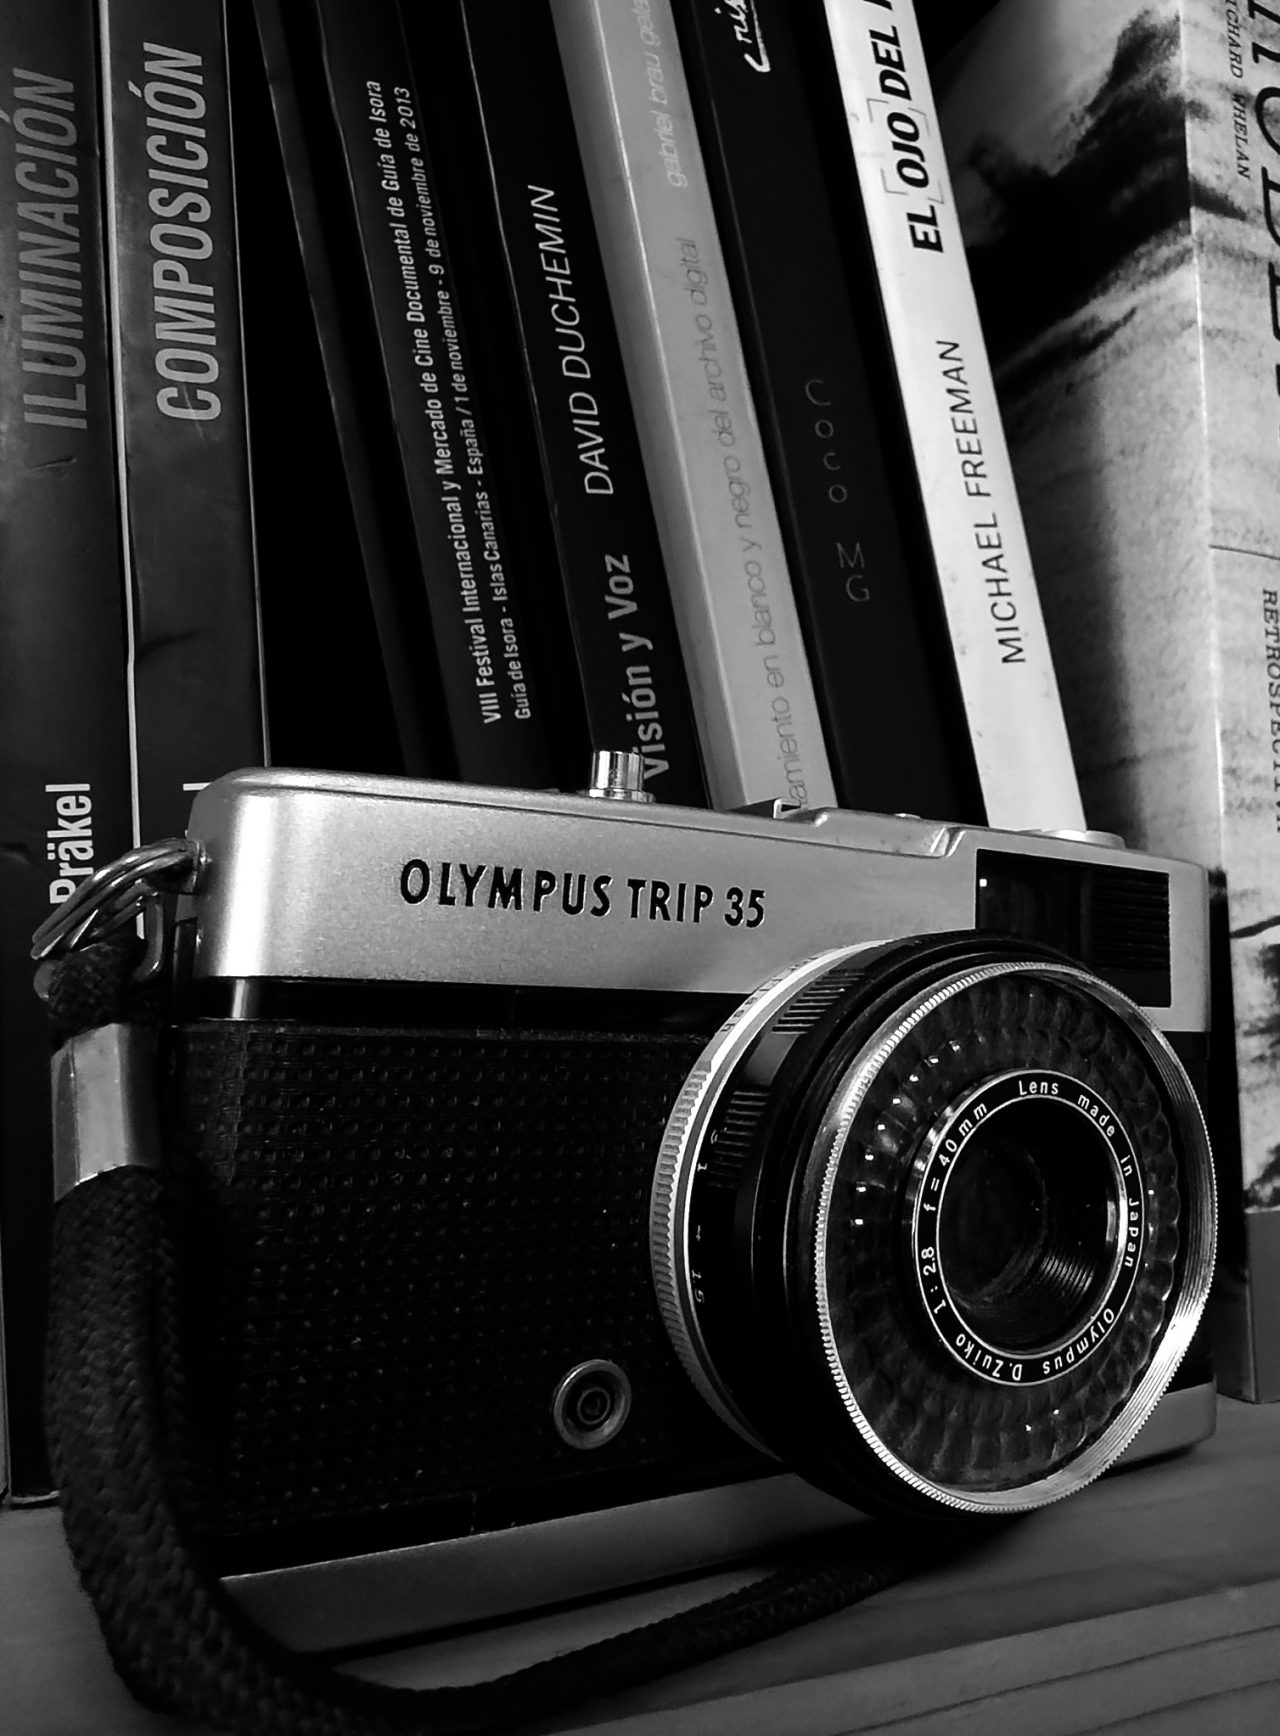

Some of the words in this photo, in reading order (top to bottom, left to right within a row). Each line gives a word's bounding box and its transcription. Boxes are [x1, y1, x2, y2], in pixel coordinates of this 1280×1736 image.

[645, 51, 669, 105] brau
[868, 25, 912, 101] DEL
[366, 80, 388, 123] Isora
[393, 86, 416, 130] 2013
[372, 127, 393, 149] de
[404, 133, 421, 152] de
[886, 111, 930, 189] OJO
[1232, 92, 1250, 180] WHELAN
[377, 153, 401, 191] Guía
[410, 157, 437, 236] noviembre
[127, 42, 222, 421] COMPOSICIÓN
[386, 196, 406, 218] de
[906, 204, 944, 253] EL
[0, 67, 87, 429] ILUMINACIÓN
[388, 222, 426, 322] Documental
[424, 238, 441, 258] de
[428, 263, 445, 275] 9
[675, 236, 709, 306] digital
[527, 185, 591, 378] DUCHEMIN
[412, 328, 434, 367] Cine
[437, 290, 464, 370] noviembre
[419, 372, 439, 393] de
[451, 373, 468, 392] de
[695, 314, 727, 401] archivo
[424, 398, 455, 475] Mercado
[569, 391, 614, 495] DAVID
[707, 410, 736, 447] del
[936, 340, 992, 498] FREEMAN
[460, 419, 484, 475] España
[442, 480, 462, 491] y
[723, 456, 753, 528] negro
[474, 491, 500, 561] Canarias
[740, 536, 762, 552] y
[441, 496, 481, 612] Internacional
[490, 563, 508, 601] Islas
[604, 554, 638, 620] Voz
[744, 560, 776, 646] blanco
[973, 512, 1026, 664] MICHAEL
[464, 618, 495, 687] Festival
[500, 618, 519, 658] Isora
[619, 632, 653, 652] y
[507, 660, 524, 680] de
[763, 654, 785, 689] en
[478, 692, 501, 724] VIII
[510, 682, 531, 719] Guía
[621, 665, 670, 780] Visión
[400, 858, 613, 917] OLYMPUS
[626, 878, 714, 924] TRIP
[723, 886, 766, 929] 35
[1018, 1080, 1059, 1096] Lens
[1077, 1094, 1115, 1137] made
[1120, 1154, 1133, 1177] in
[1124, 1198, 1140, 1267] Japan
[955, 1333, 1023, 1381] D.Zuiko
[1042, 1308, 1115, 1374] Olympus
